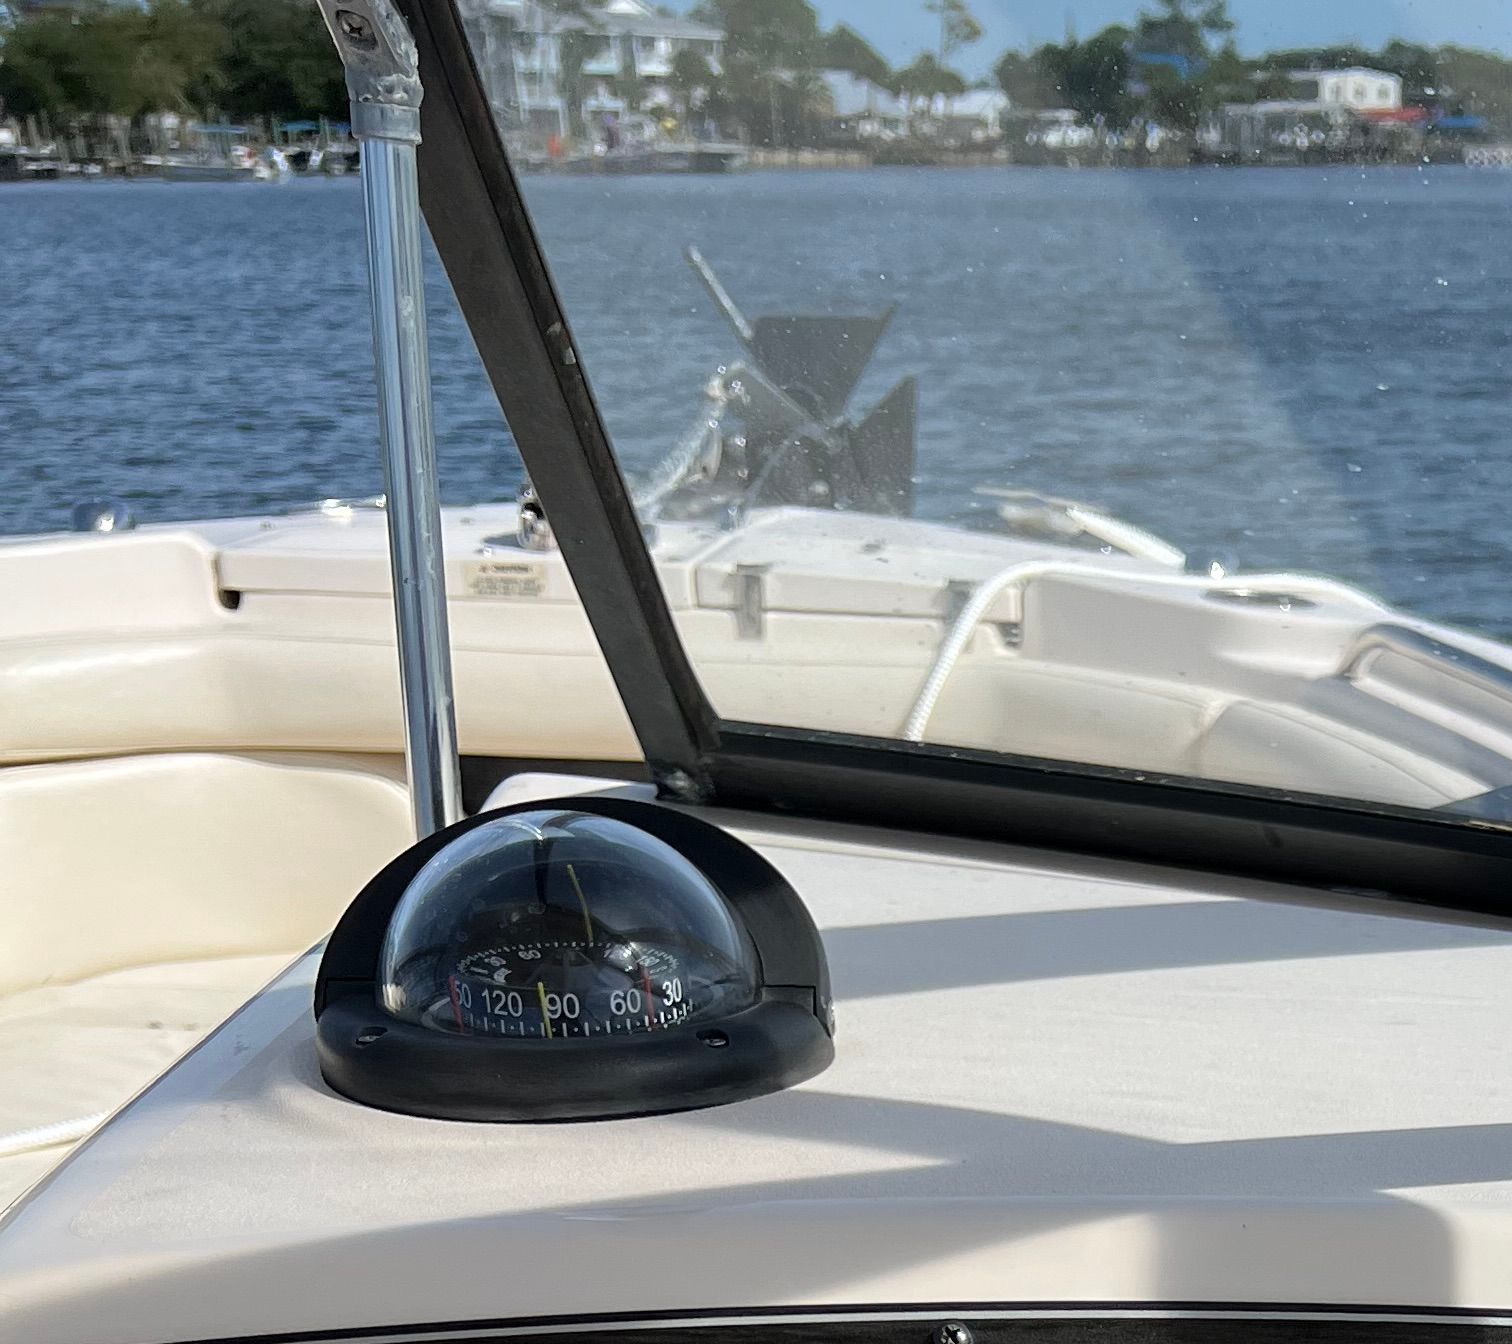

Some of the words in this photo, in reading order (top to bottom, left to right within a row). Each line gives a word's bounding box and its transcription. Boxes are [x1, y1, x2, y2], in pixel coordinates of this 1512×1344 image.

[481, 988, 523, 1018] 120
[546, 993, 580, 1019] 90
[610, 988, 641, 1015] 60
[662, 978, 682, 1006] 30
